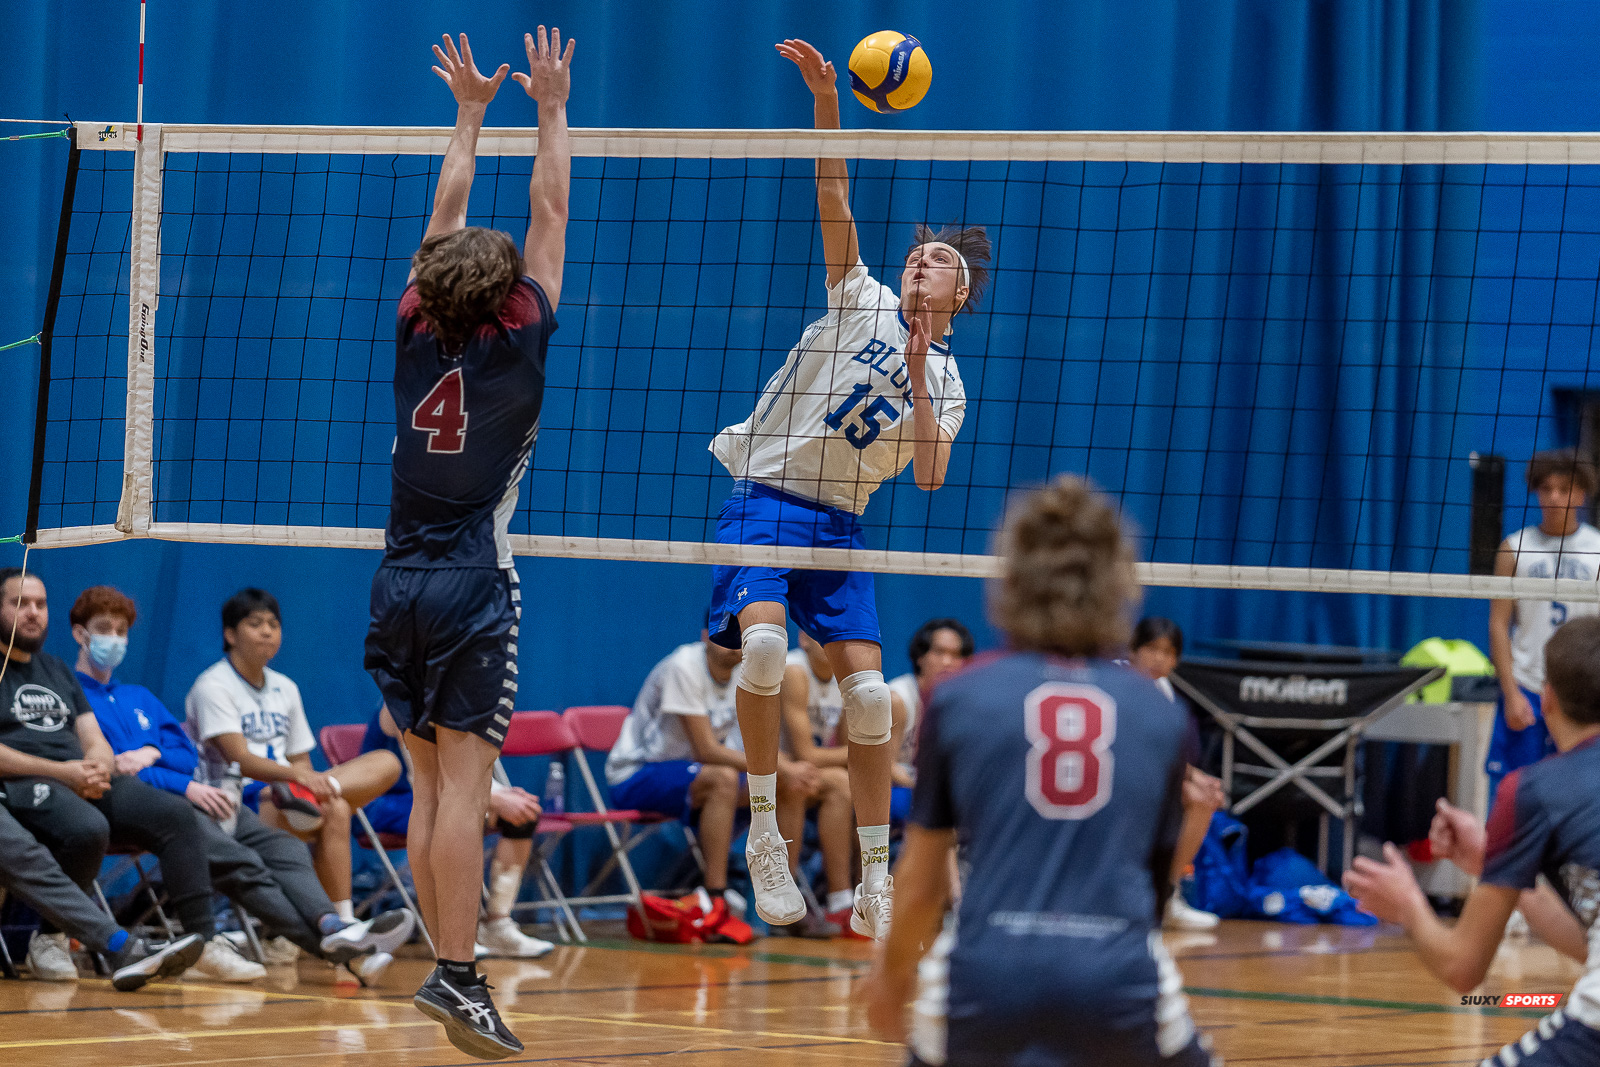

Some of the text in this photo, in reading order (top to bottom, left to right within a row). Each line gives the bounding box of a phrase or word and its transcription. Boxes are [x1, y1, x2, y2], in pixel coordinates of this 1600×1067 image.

[411, 366, 469, 453] 4
[823, 383, 900, 450] 15
[1024, 681, 1117, 820] 8
